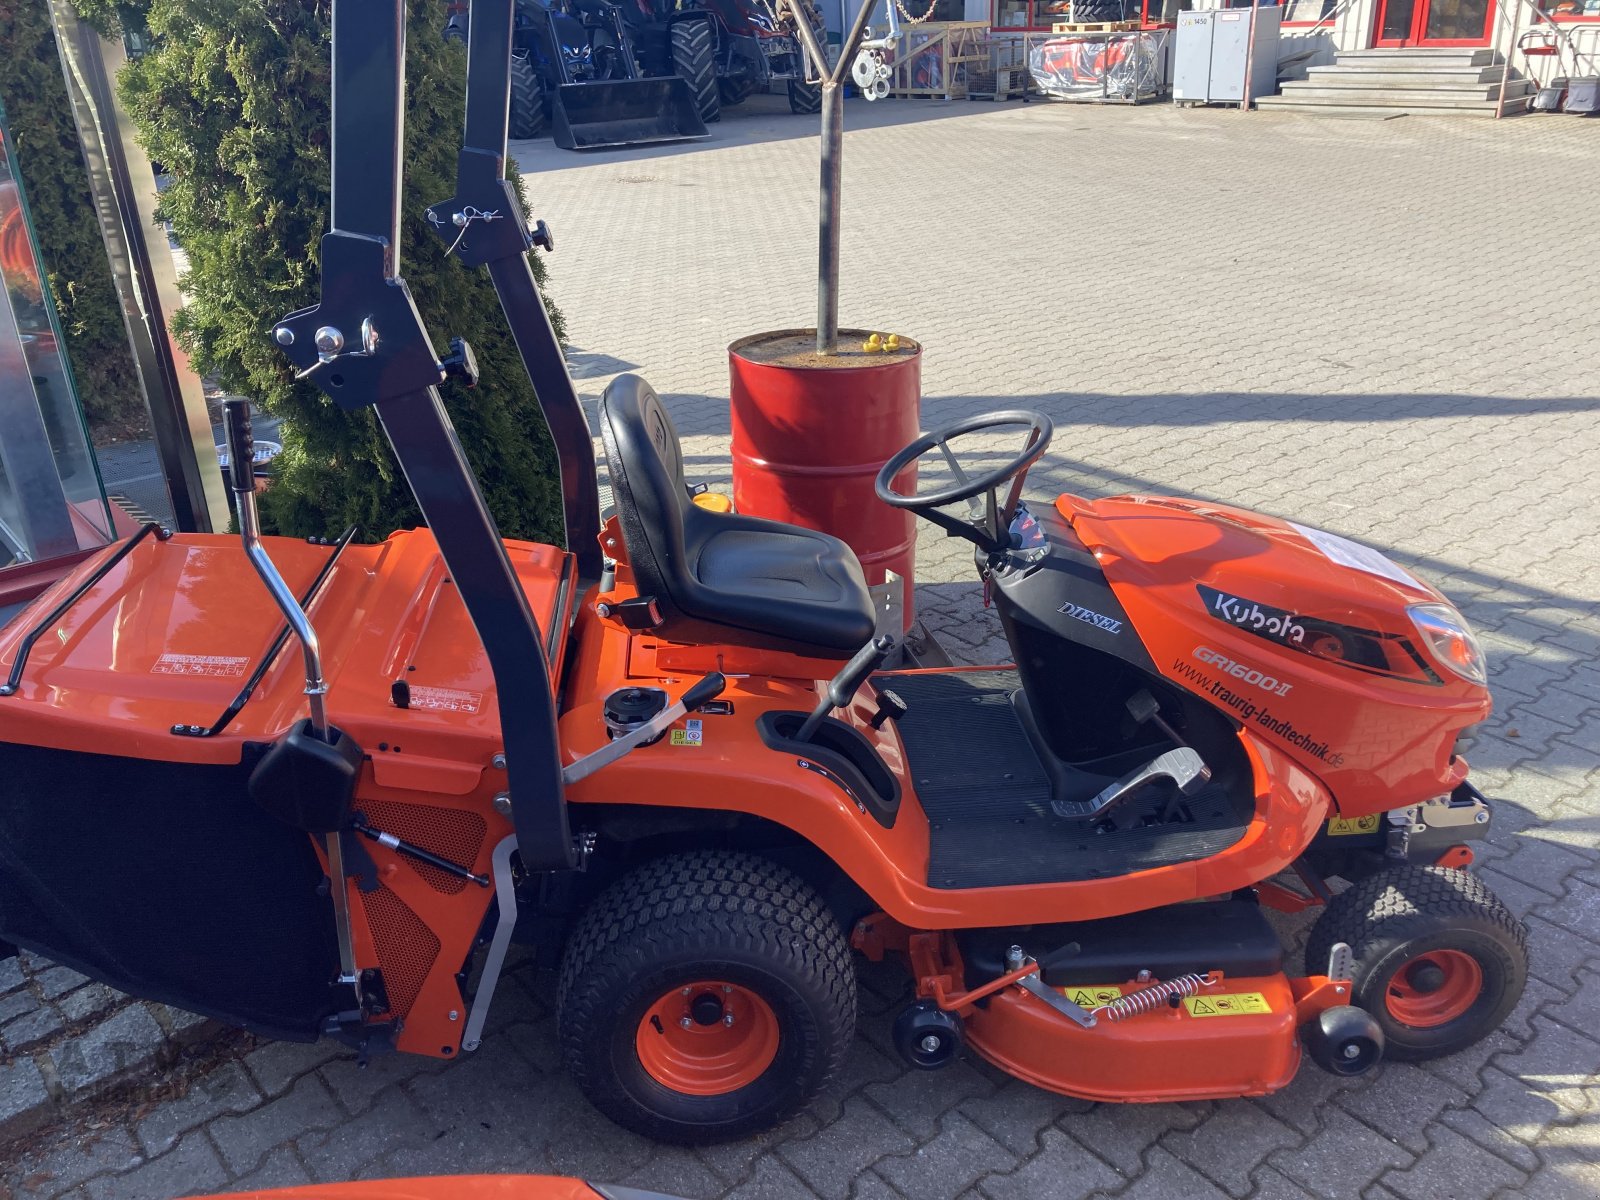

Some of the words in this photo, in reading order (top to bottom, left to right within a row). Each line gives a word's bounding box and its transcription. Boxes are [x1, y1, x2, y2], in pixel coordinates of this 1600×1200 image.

[1056, 601, 1122, 634] DIESEL
[1215, 593, 1305, 643] Kubota
[1172, 658, 1345, 769] www.traurig-landtechnik.de
